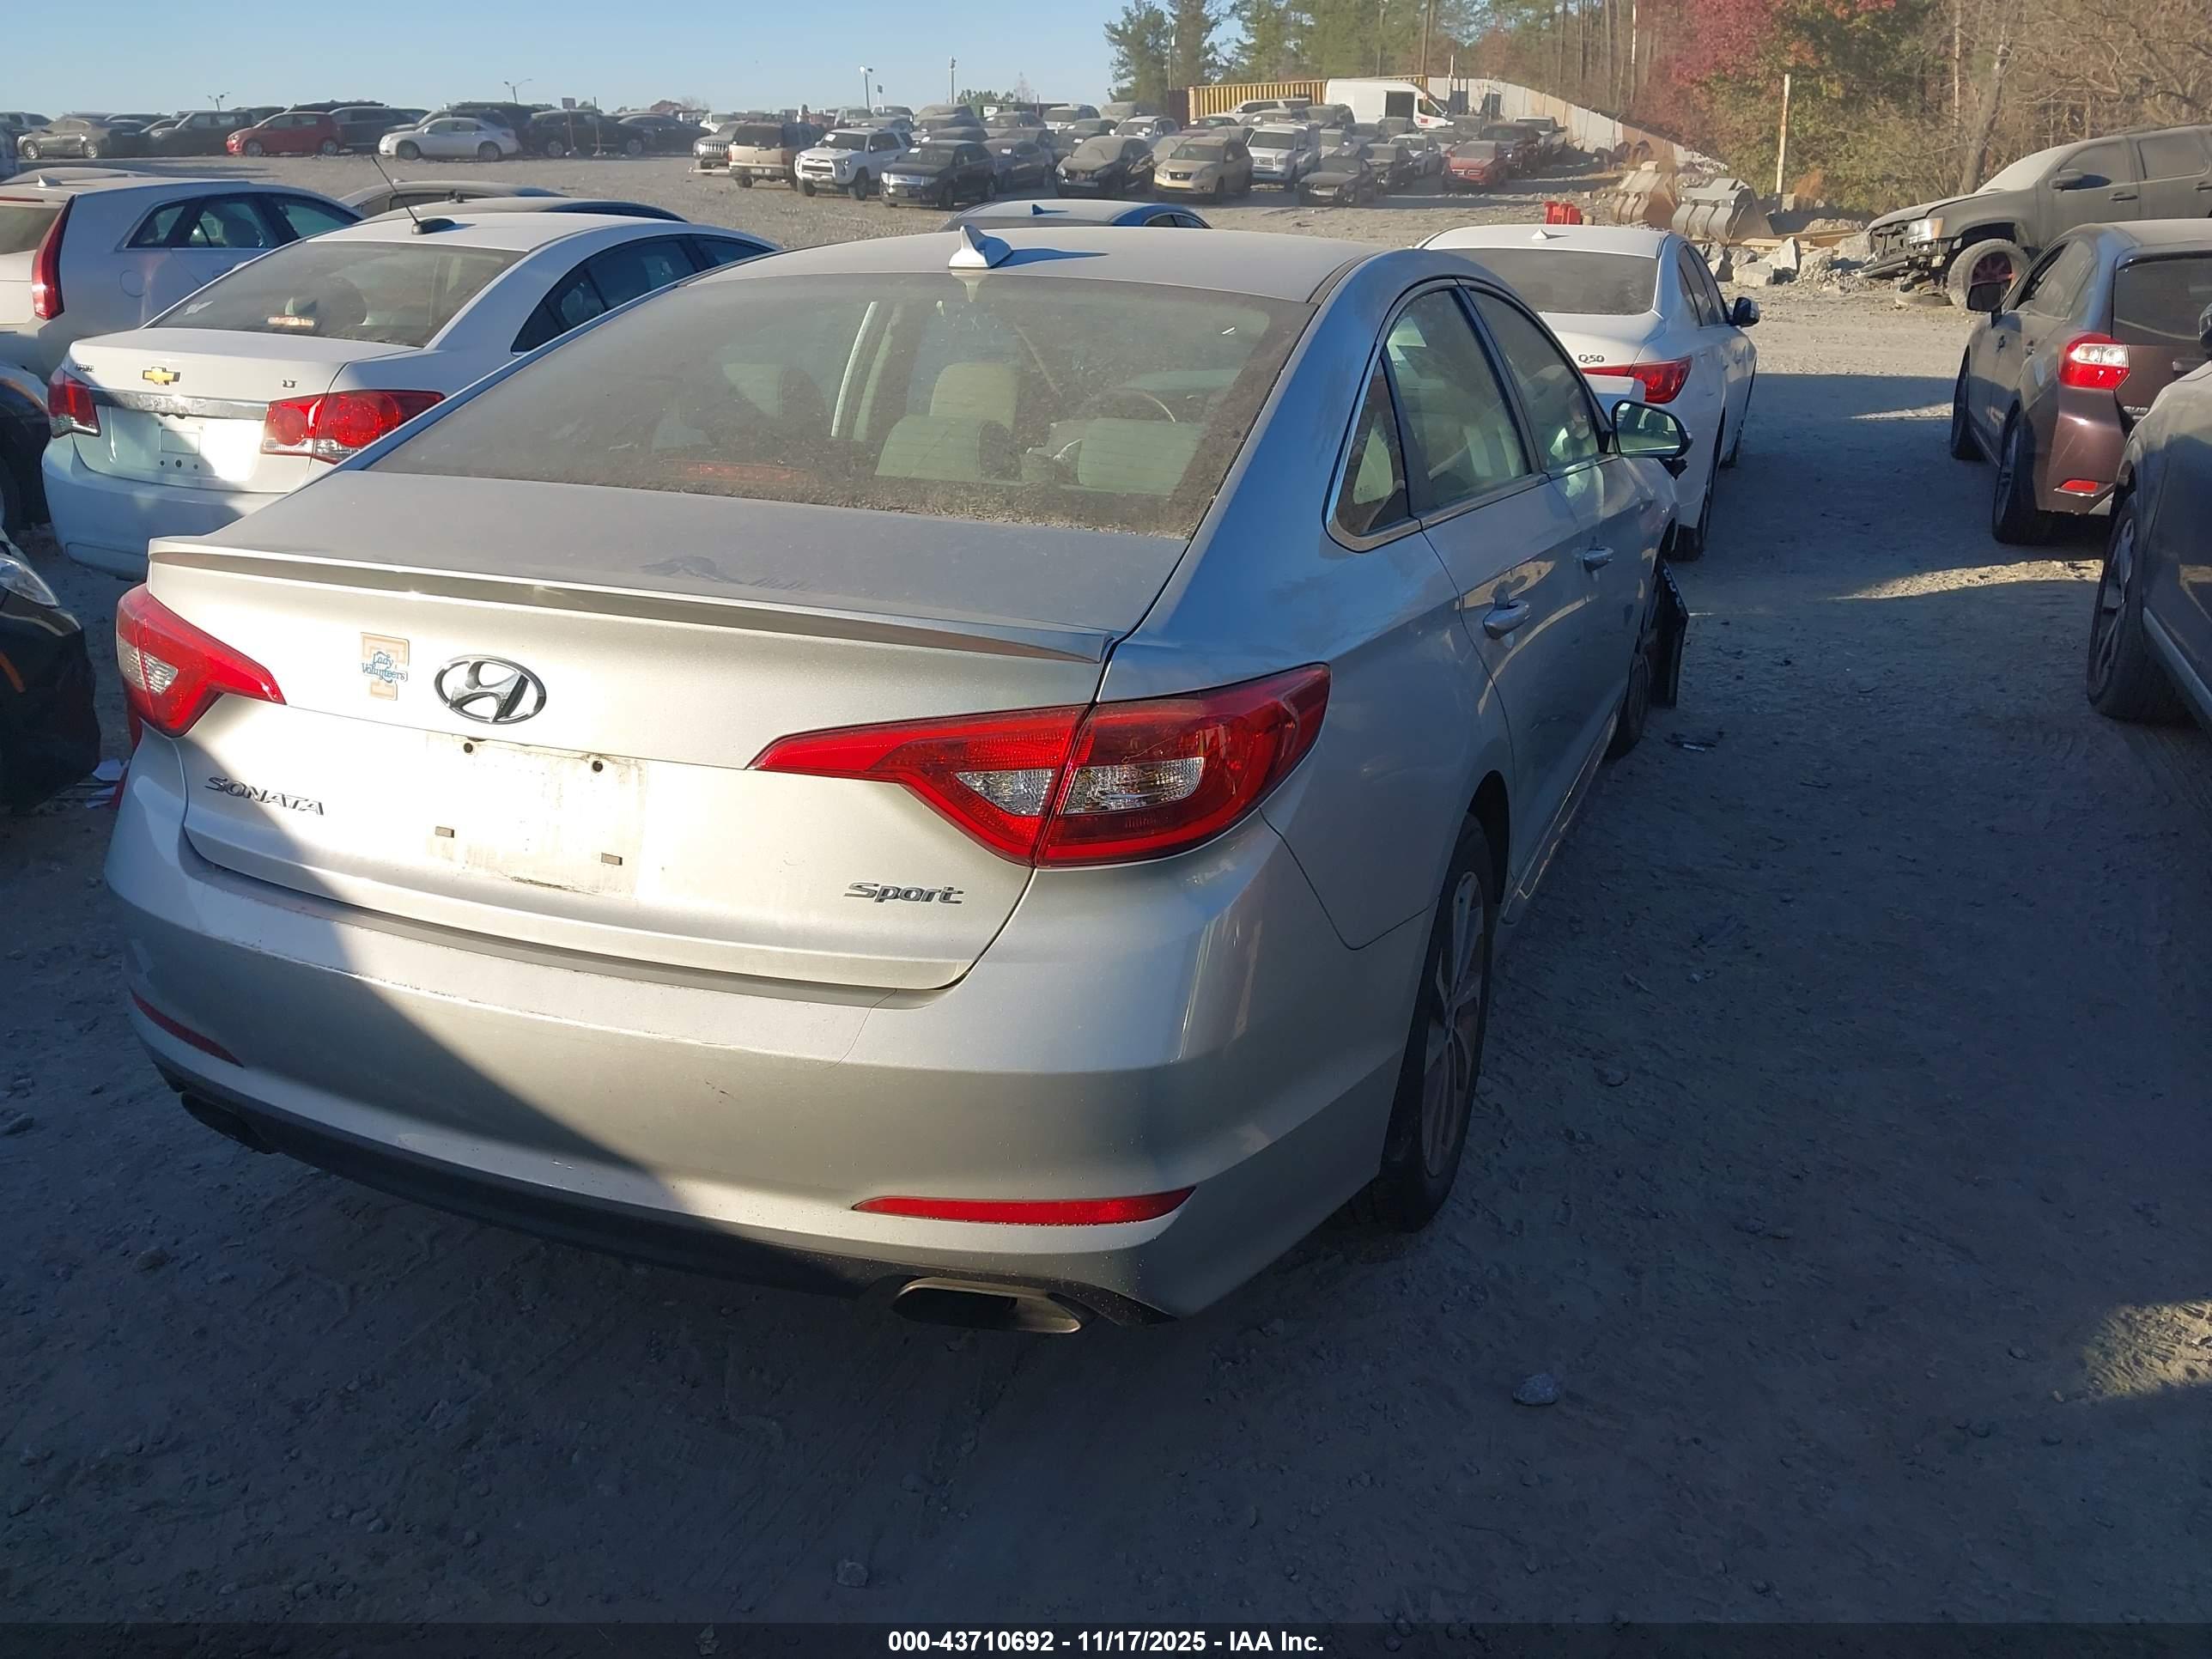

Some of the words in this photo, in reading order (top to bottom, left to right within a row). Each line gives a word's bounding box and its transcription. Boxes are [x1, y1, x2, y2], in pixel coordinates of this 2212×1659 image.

[1578, 354, 1605, 364] Q50
[373, 651, 395, 669] Lady
[362, 662, 409, 684] Volunteers
[204, 775, 324, 816] SONATA
[844, 881, 964, 904] Sport
